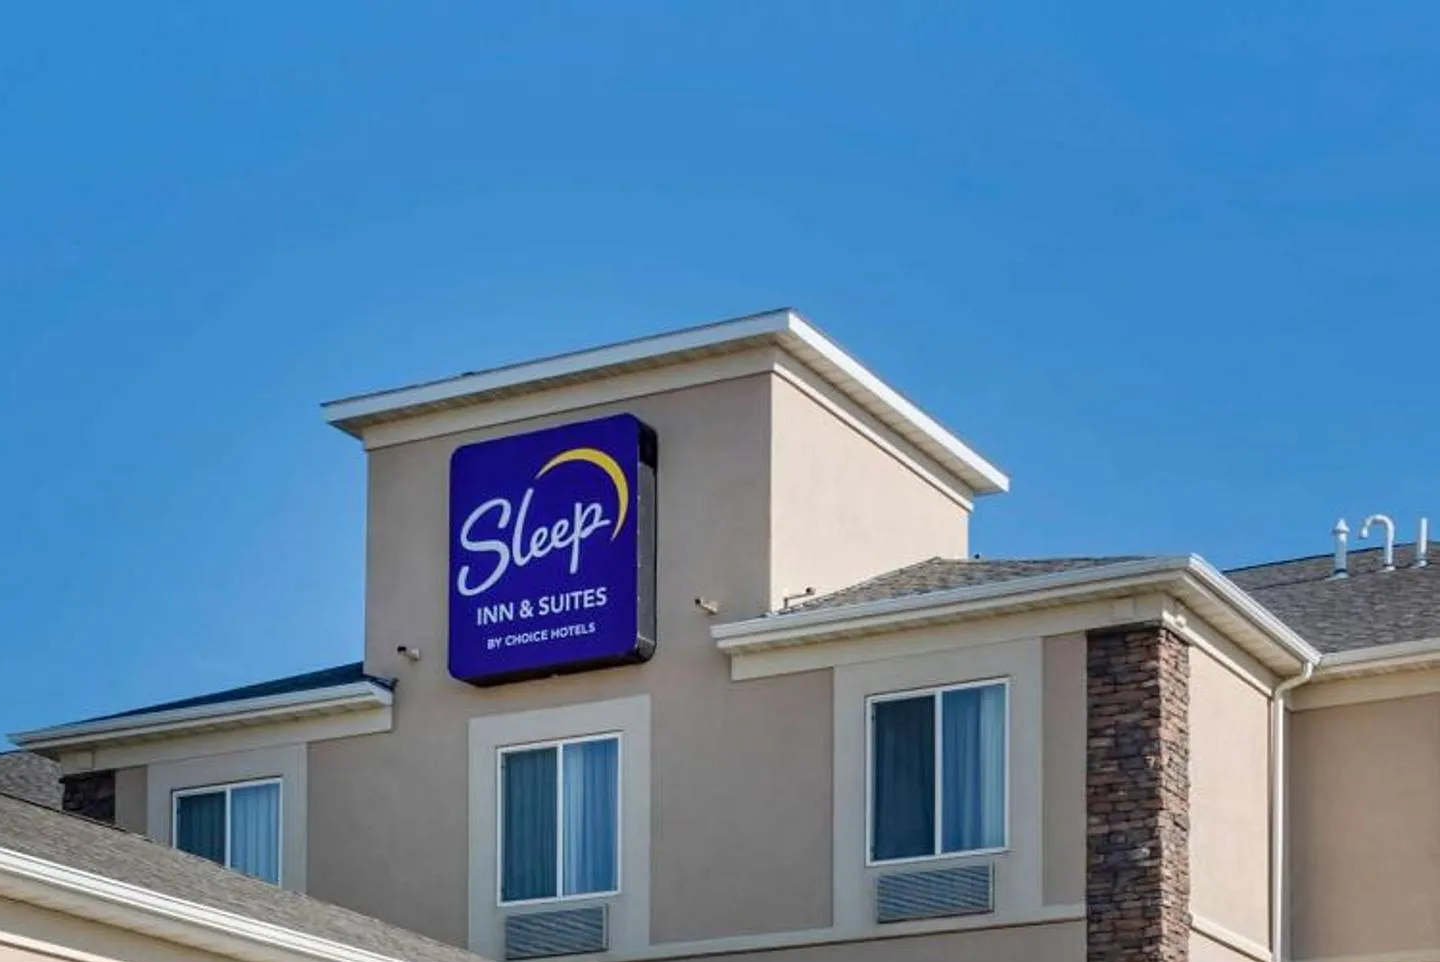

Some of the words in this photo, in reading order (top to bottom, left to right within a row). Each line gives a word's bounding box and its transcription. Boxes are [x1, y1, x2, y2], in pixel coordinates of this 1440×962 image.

[457, 488, 611, 596] Sleep
[477, 602, 514, 626] INN
[519, 599, 534, 619] &
[538, 587, 608, 616] SUITES
[487, 637, 502, 650] BY
[505, 629, 549, 647] CHOICE
[551, 622, 596, 640] HOTELS
